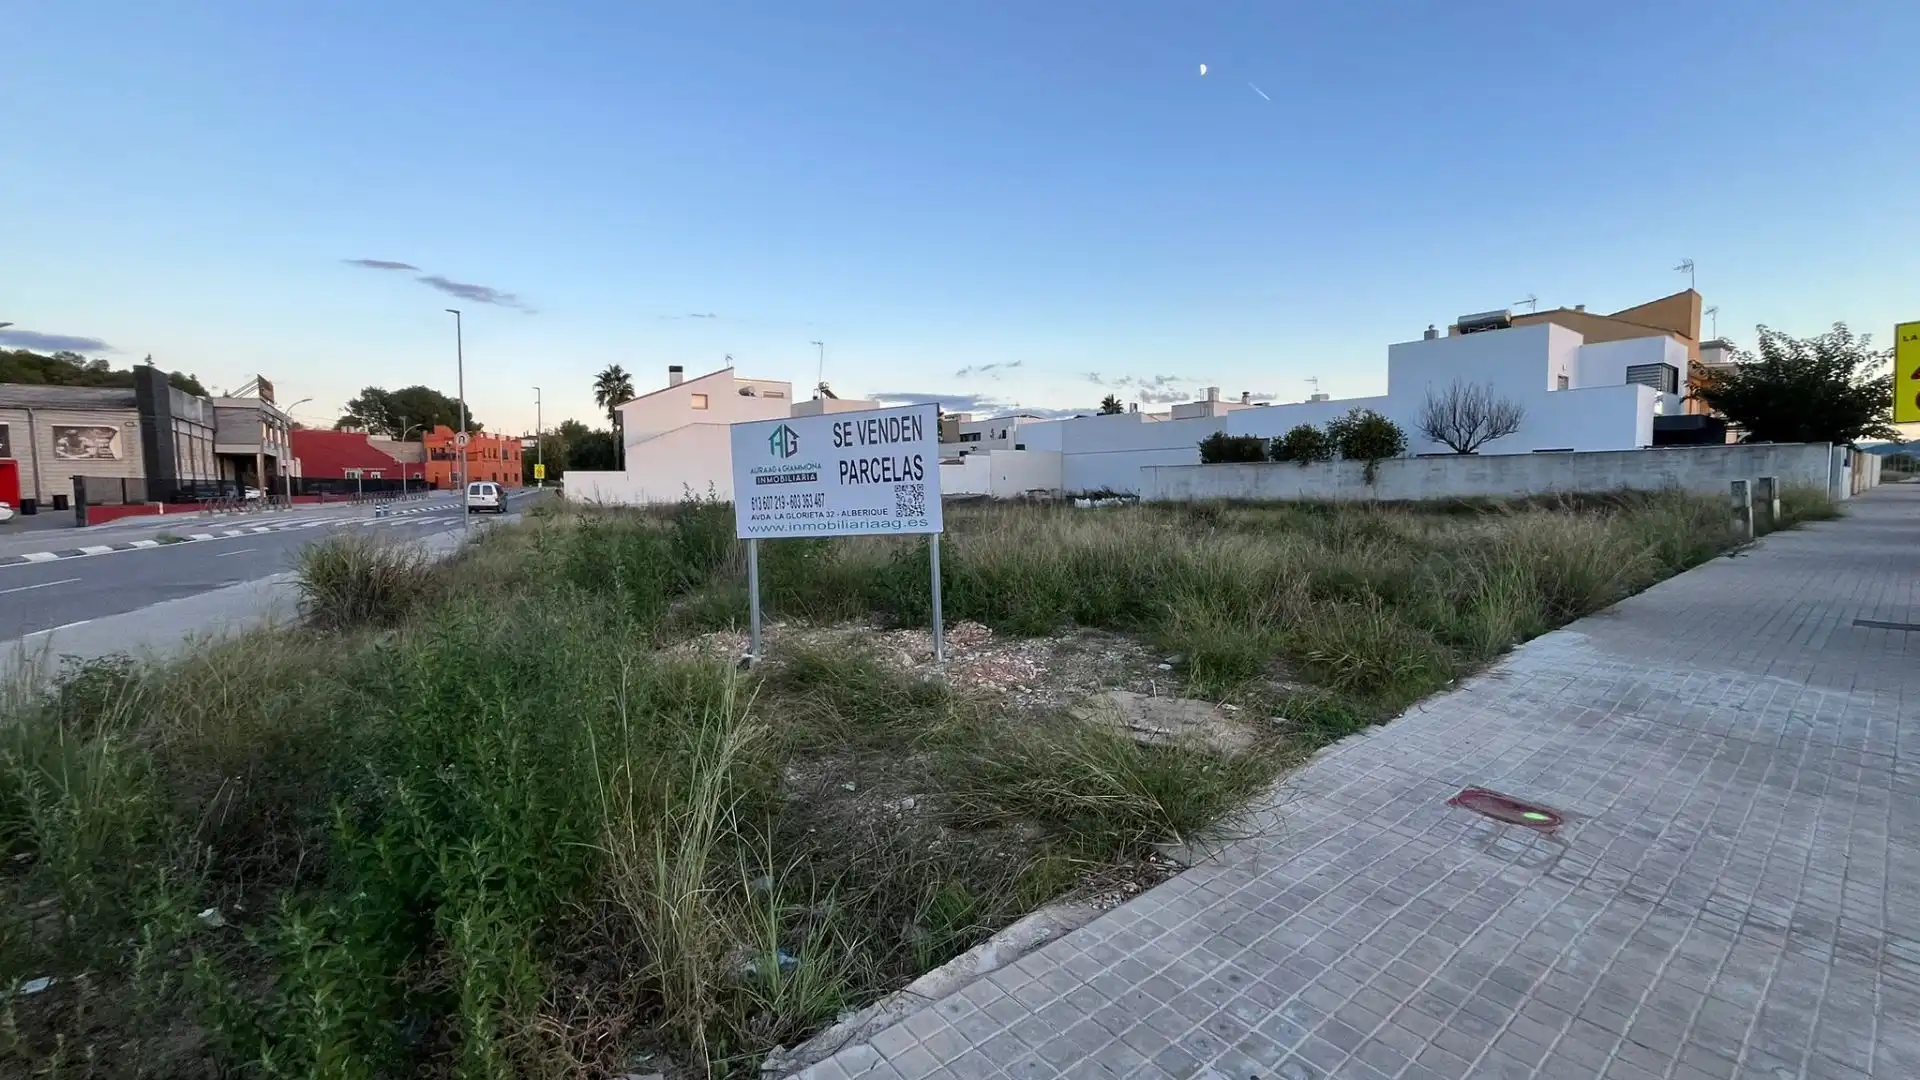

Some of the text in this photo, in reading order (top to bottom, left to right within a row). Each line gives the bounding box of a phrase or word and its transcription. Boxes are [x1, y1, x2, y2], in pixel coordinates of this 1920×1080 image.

[833, 414, 923, 448] SE VENDEN
[782, 463, 822, 473] GIAMMONA
[839, 454, 924, 485] PARCELAS
[757, 474, 816, 484] INMOBILIARIA
[775, 494, 786, 510] 219
[786, 511, 824, 520] GLORIETA
[826, 510, 835, 518] 32
[841, 508, 888, 517] ALBERIQUE
[748, 518, 928, 533] www.inmobiliariaag.es
